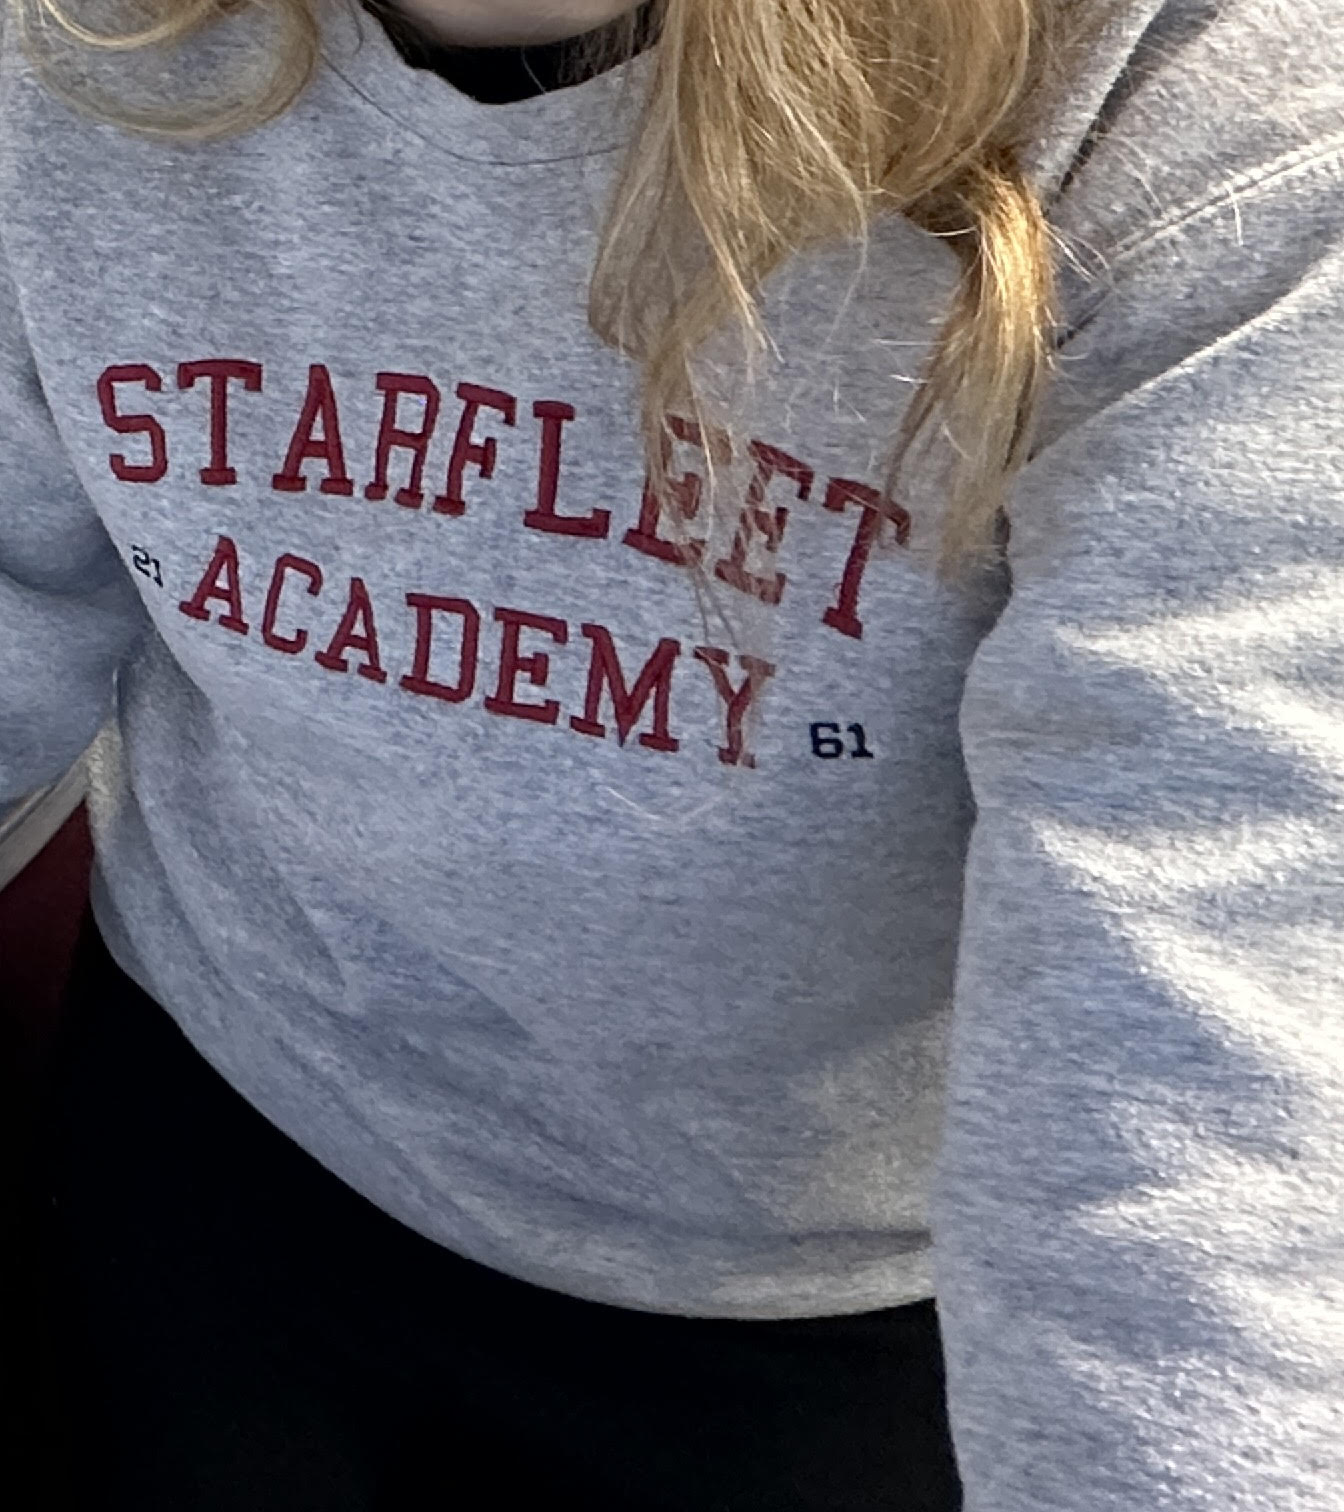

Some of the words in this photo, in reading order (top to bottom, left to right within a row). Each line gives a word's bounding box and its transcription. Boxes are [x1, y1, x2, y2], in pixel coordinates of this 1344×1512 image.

[96, 357, 913, 640] STARFLEET
[130, 544, 166, 589] 21
[178, 534, 776, 769] ACADEMY
[809, 721, 875, 760] 61
